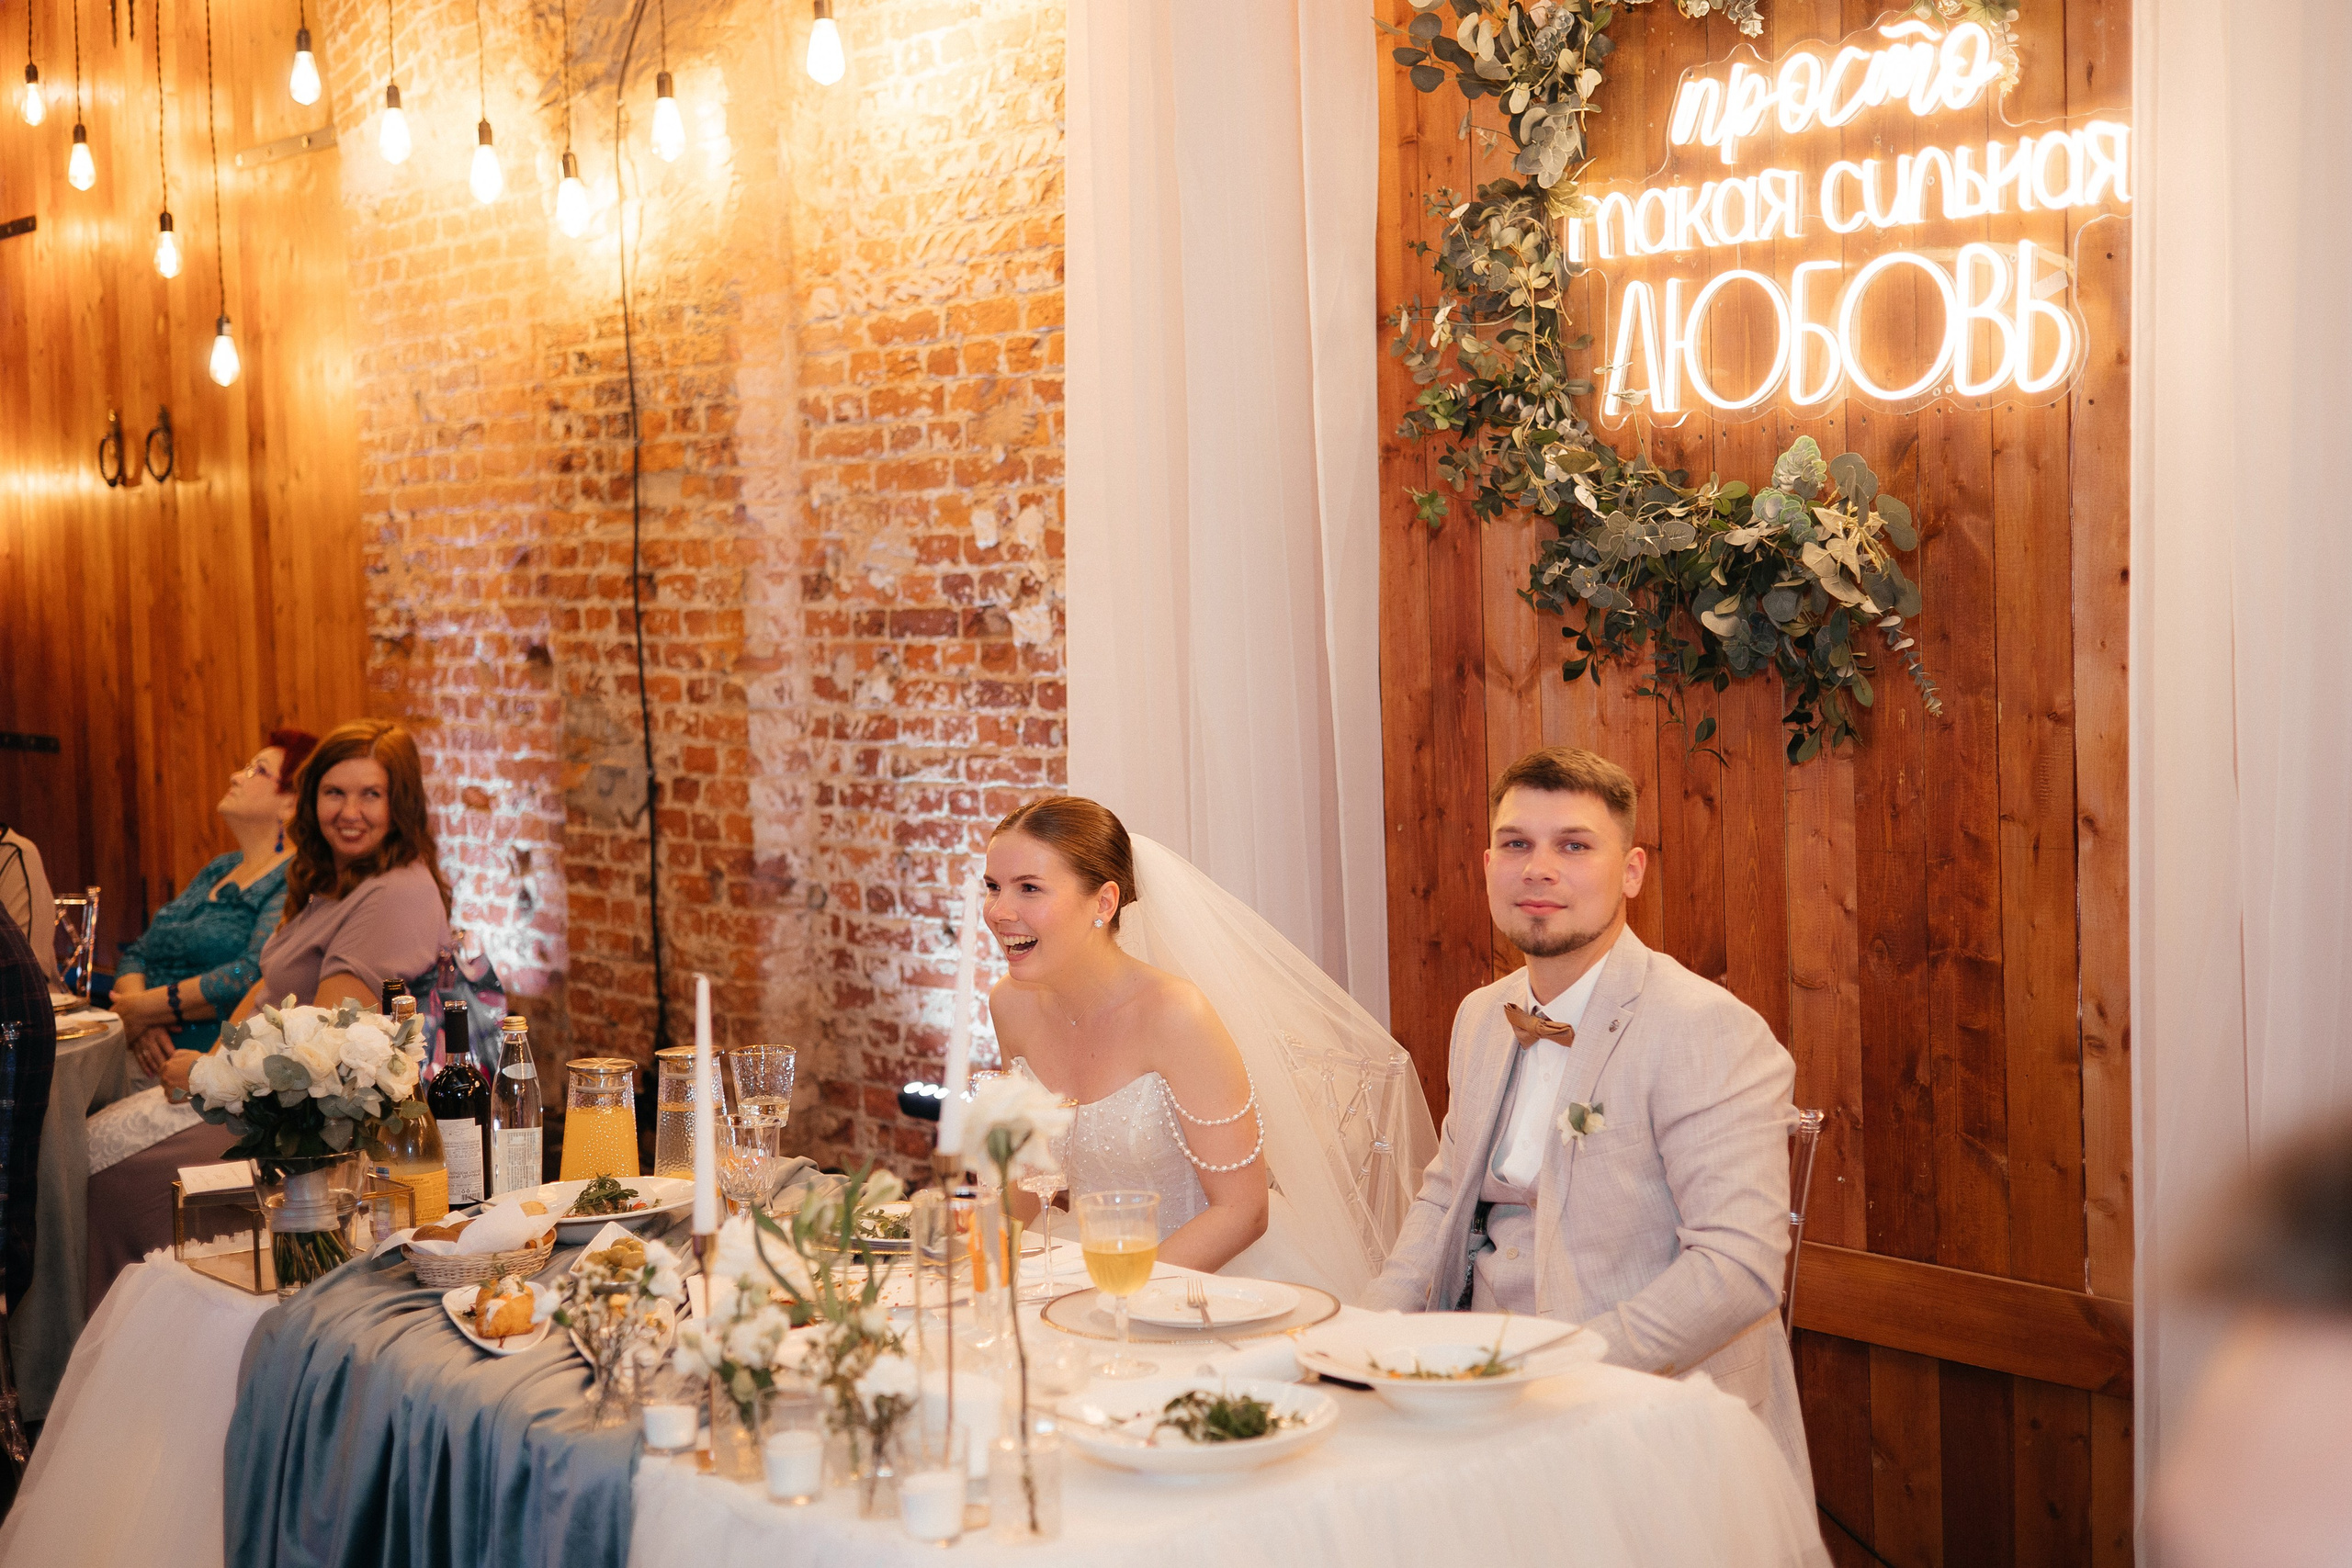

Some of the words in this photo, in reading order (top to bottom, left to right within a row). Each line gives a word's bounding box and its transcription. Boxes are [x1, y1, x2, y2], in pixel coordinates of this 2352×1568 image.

[1670, 20, 2001, 164] просто
[1567, 169, 1803, 263] такая
[1820, 119, 2132, 233] сильная
[1604, 239, 2074, 416] ЛЮБОВЬ
